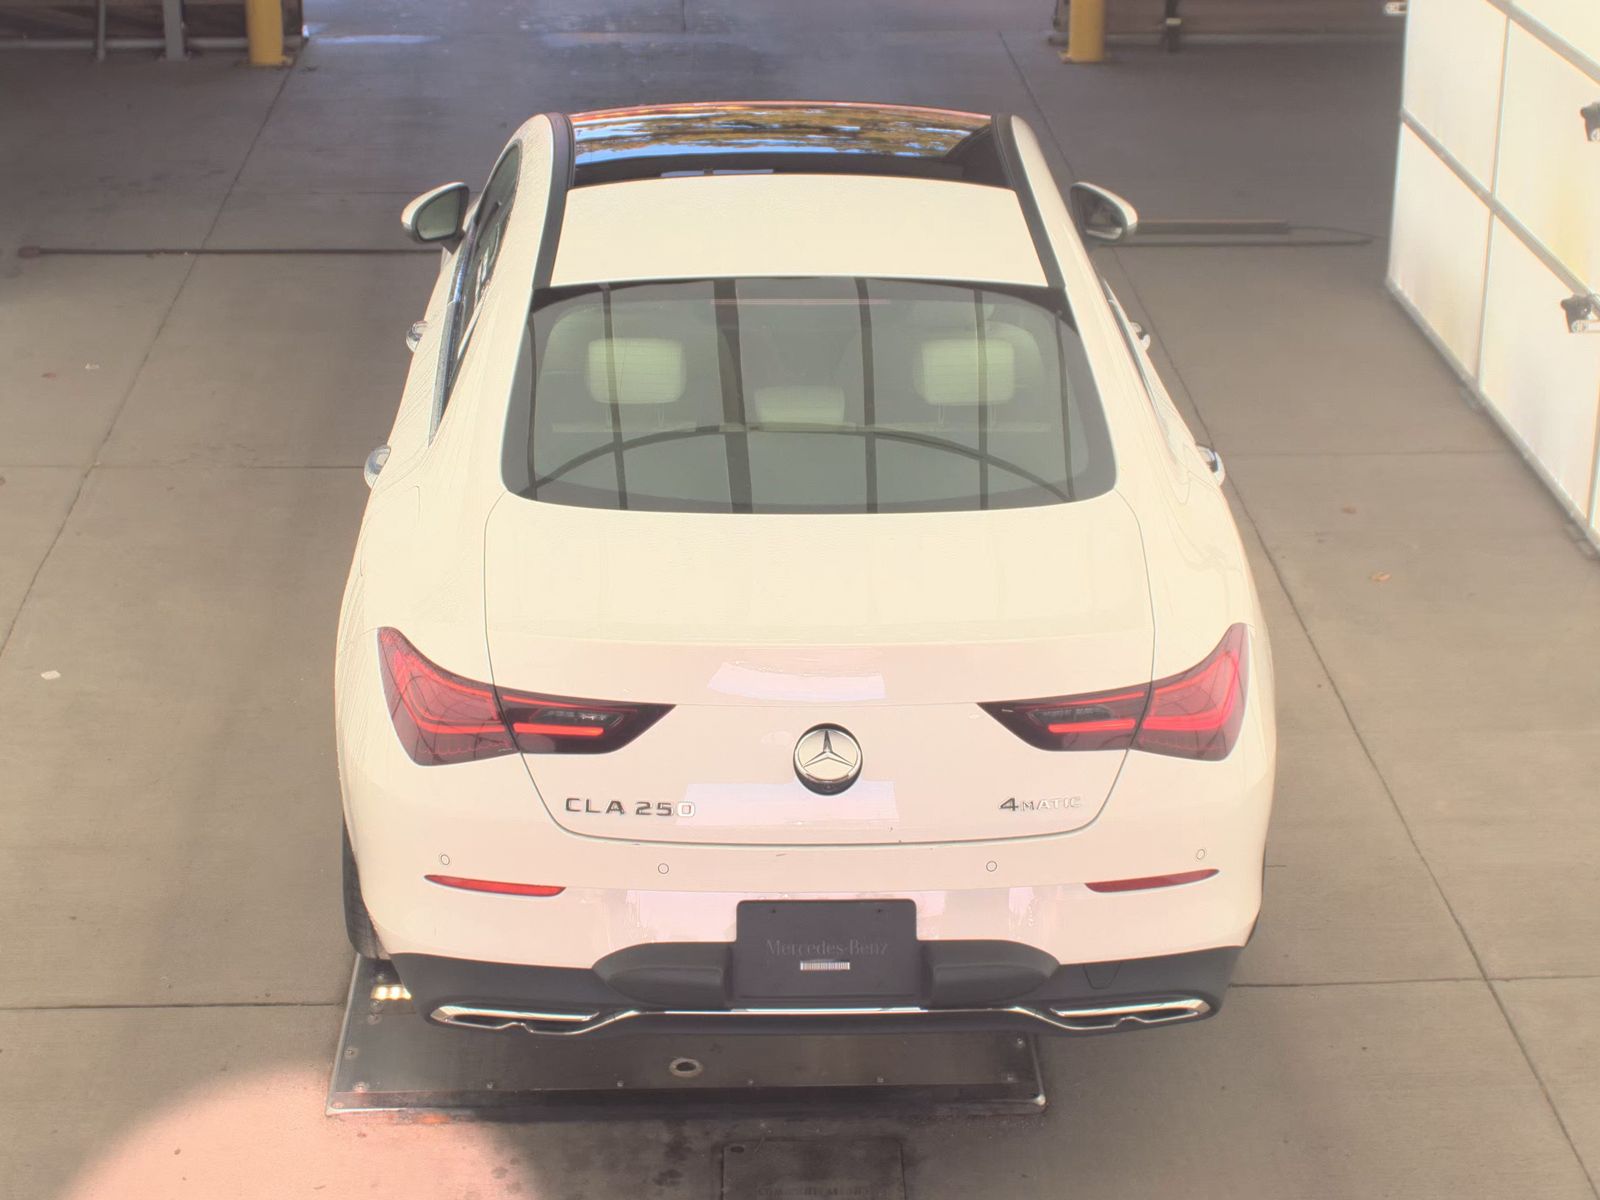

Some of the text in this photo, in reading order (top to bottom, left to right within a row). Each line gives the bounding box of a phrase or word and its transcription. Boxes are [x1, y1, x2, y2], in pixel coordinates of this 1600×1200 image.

[565, 798, 696, 817] CLA 250
[999, 796, 1081, 812] 4MATIC
[766, 939, 888, 955] Mercedes-Benz
